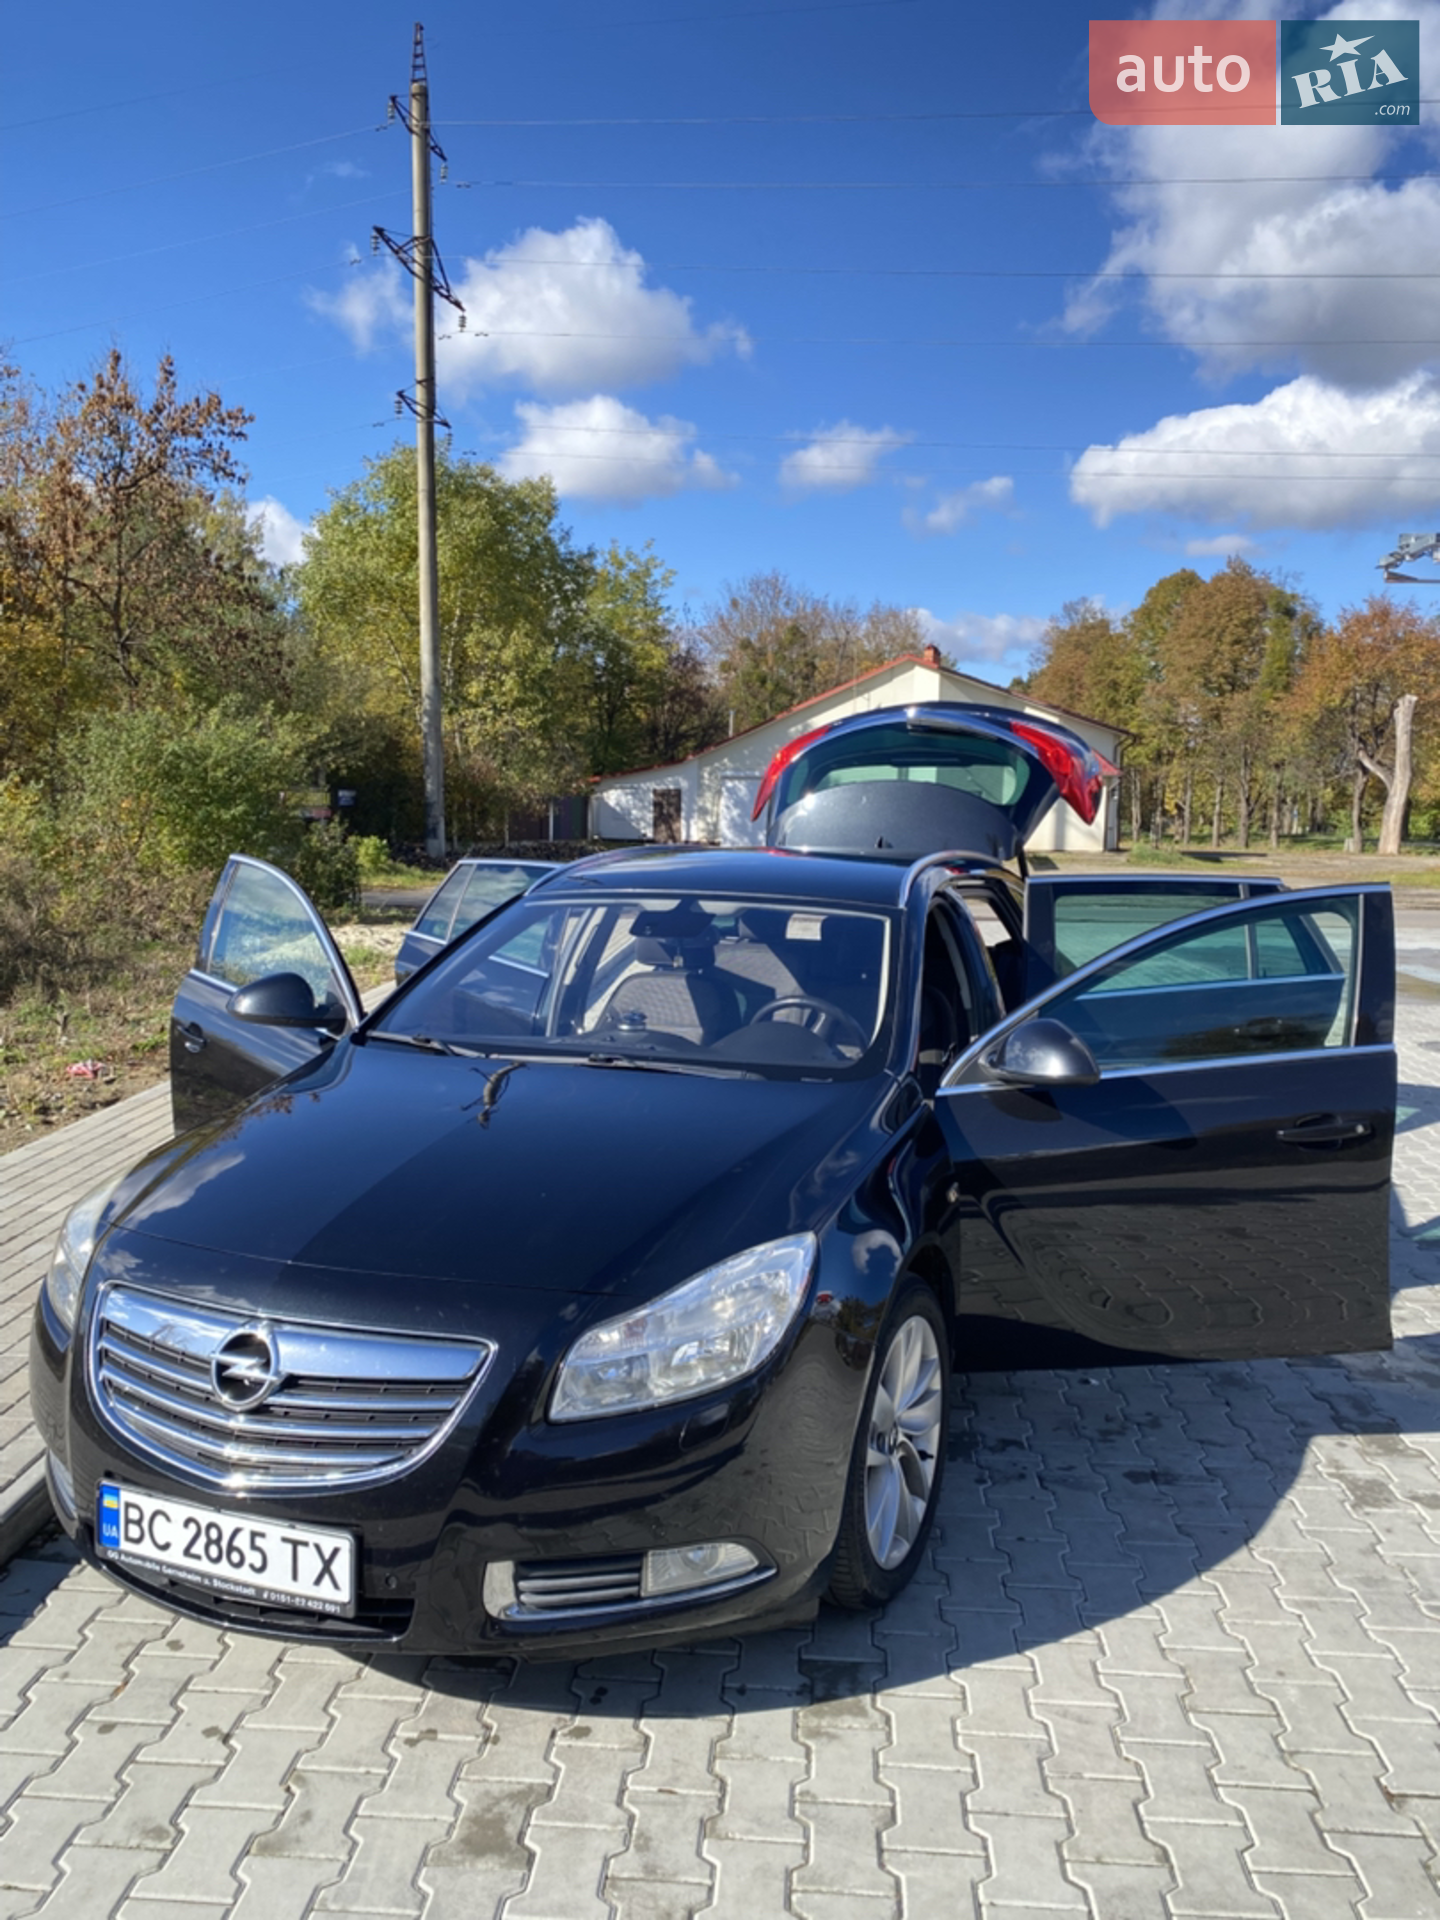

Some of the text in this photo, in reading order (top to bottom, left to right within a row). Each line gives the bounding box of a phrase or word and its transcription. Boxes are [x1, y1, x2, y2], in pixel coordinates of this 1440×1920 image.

[102, 1522, 119, 1539] UA
[123, 1501, 341, 1591] BC 2865 TX
